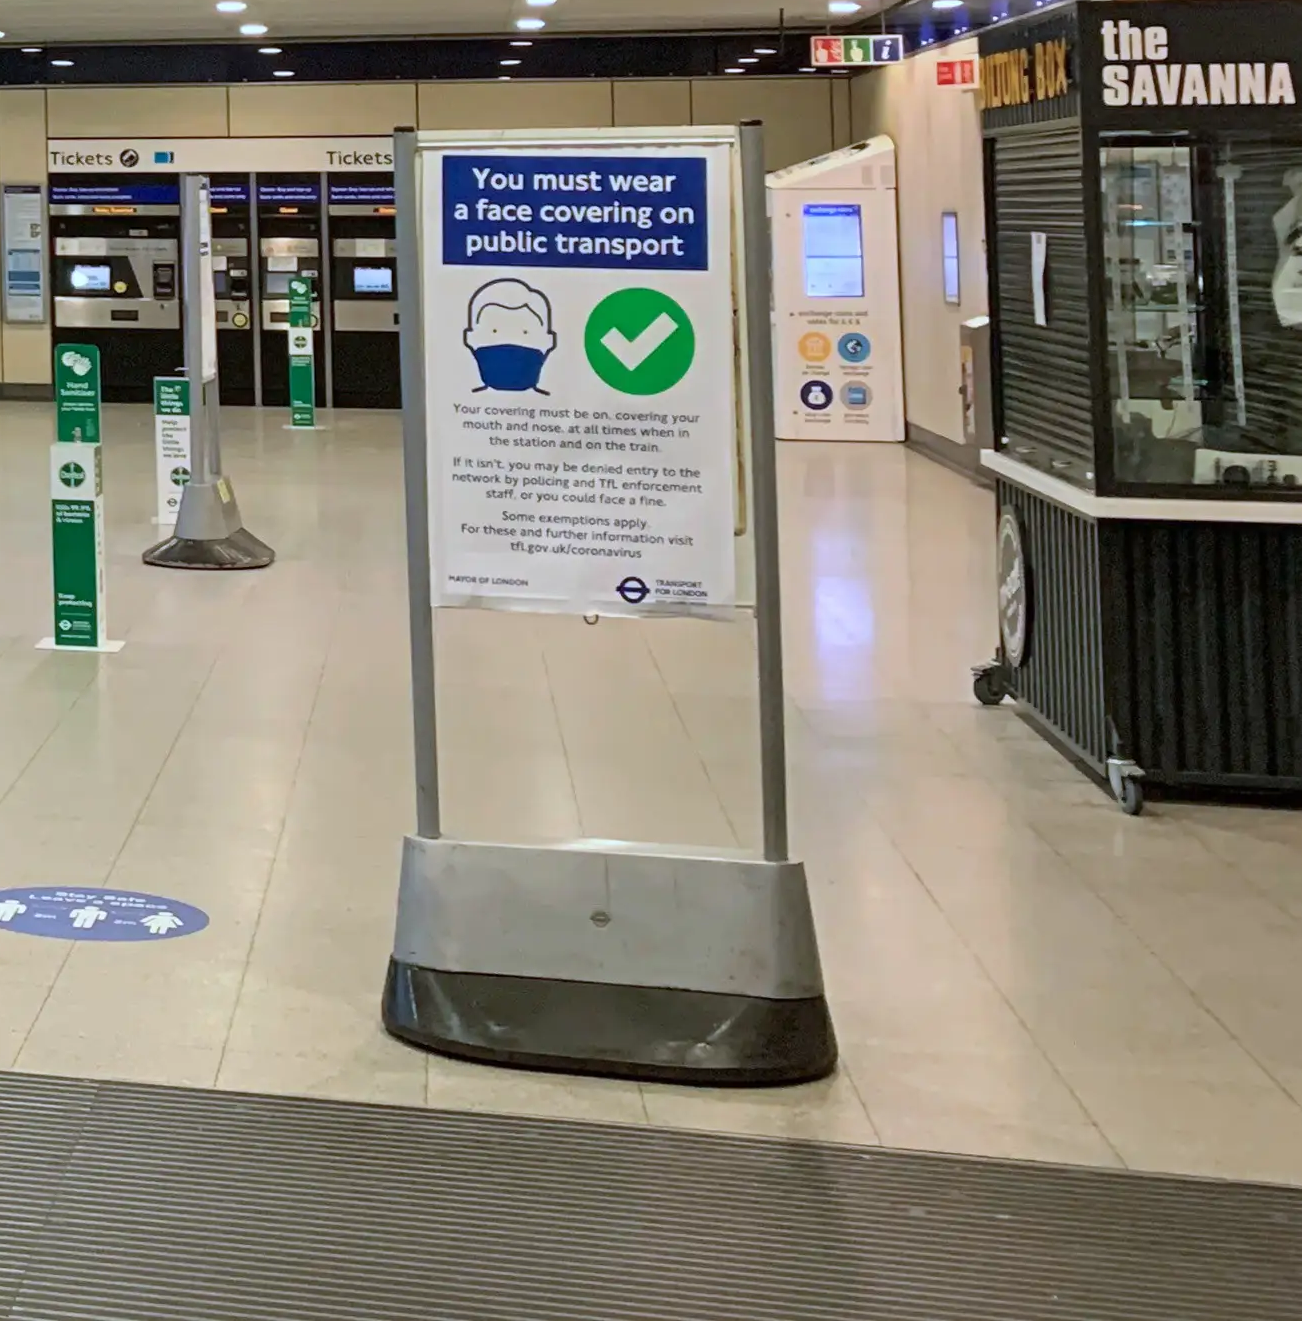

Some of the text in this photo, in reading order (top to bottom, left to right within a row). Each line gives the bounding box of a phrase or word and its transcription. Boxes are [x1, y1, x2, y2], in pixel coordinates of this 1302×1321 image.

[1101, 20, 1168, 61] the
[1035, 37, 1068, 101] BOX
[1101, 62, 1297, 107] SAVANNA
[50, 151, 113, 166] Tickets
[326, 151, 393, 166] Tickets
[472, 167, 676, 192] You must wear
[454, 199, 694, 228] a face covering on
[466, 231, 685, 260] public transport
[66, 382, 89, 390] Hand
[454, 403, 481, 414] Your
[484, 406, 535, 419] covering
[539, 408, 570, 419] must
[573, 408, 589, 419] be
[615, 411, 668, 425] covering
[671, 414, 700, 424] your
[462, 420, 502, 431] mouth
[506, 421, 528, 432] and
[568, 425, 581, 435] at
[583, 424, 599, 435] all
[602, 425, 637, 437] times
[640, 427, 675, 438] when
[678, 427, 690, 438] in
[489, 436, 661, 453] the station and on the train.
[453, 457, 461, 467] If
[464, 458, 473, 468] it
[508, 462, 531, 473] you
[534, 463, 559, 474] may
[563, 462, 578, 473] be
[581, 463, 623, 475] denied
[626, 467, 659, 478] entry
[662, 468, 676, 478] to
[679, 467, 701, 478] the
[452, 473, 703, 494] network by policing and TfL enforcement
[520, 491, 534, 500] or
[536, 493, 559, 504] you
[562, 492, 596, 504] could
[599, 493, 626, 505] face
[629, 497, 636, 505] a
[640, 496, 667, 507] fine.
[502, 510, 535, 522] Some
[539, 513, 610, 527] exemptions
[460, 523, 694, 546] For these and further information visit
[510, 541, 642, 559] tfl.gov.uk/coronavirus
[448, 575, 528, 587] MAYOR OF LONDON
[655, 579, 702, 588] TRANSPORT
[655, 588, 708, 597] FOR LONDON
